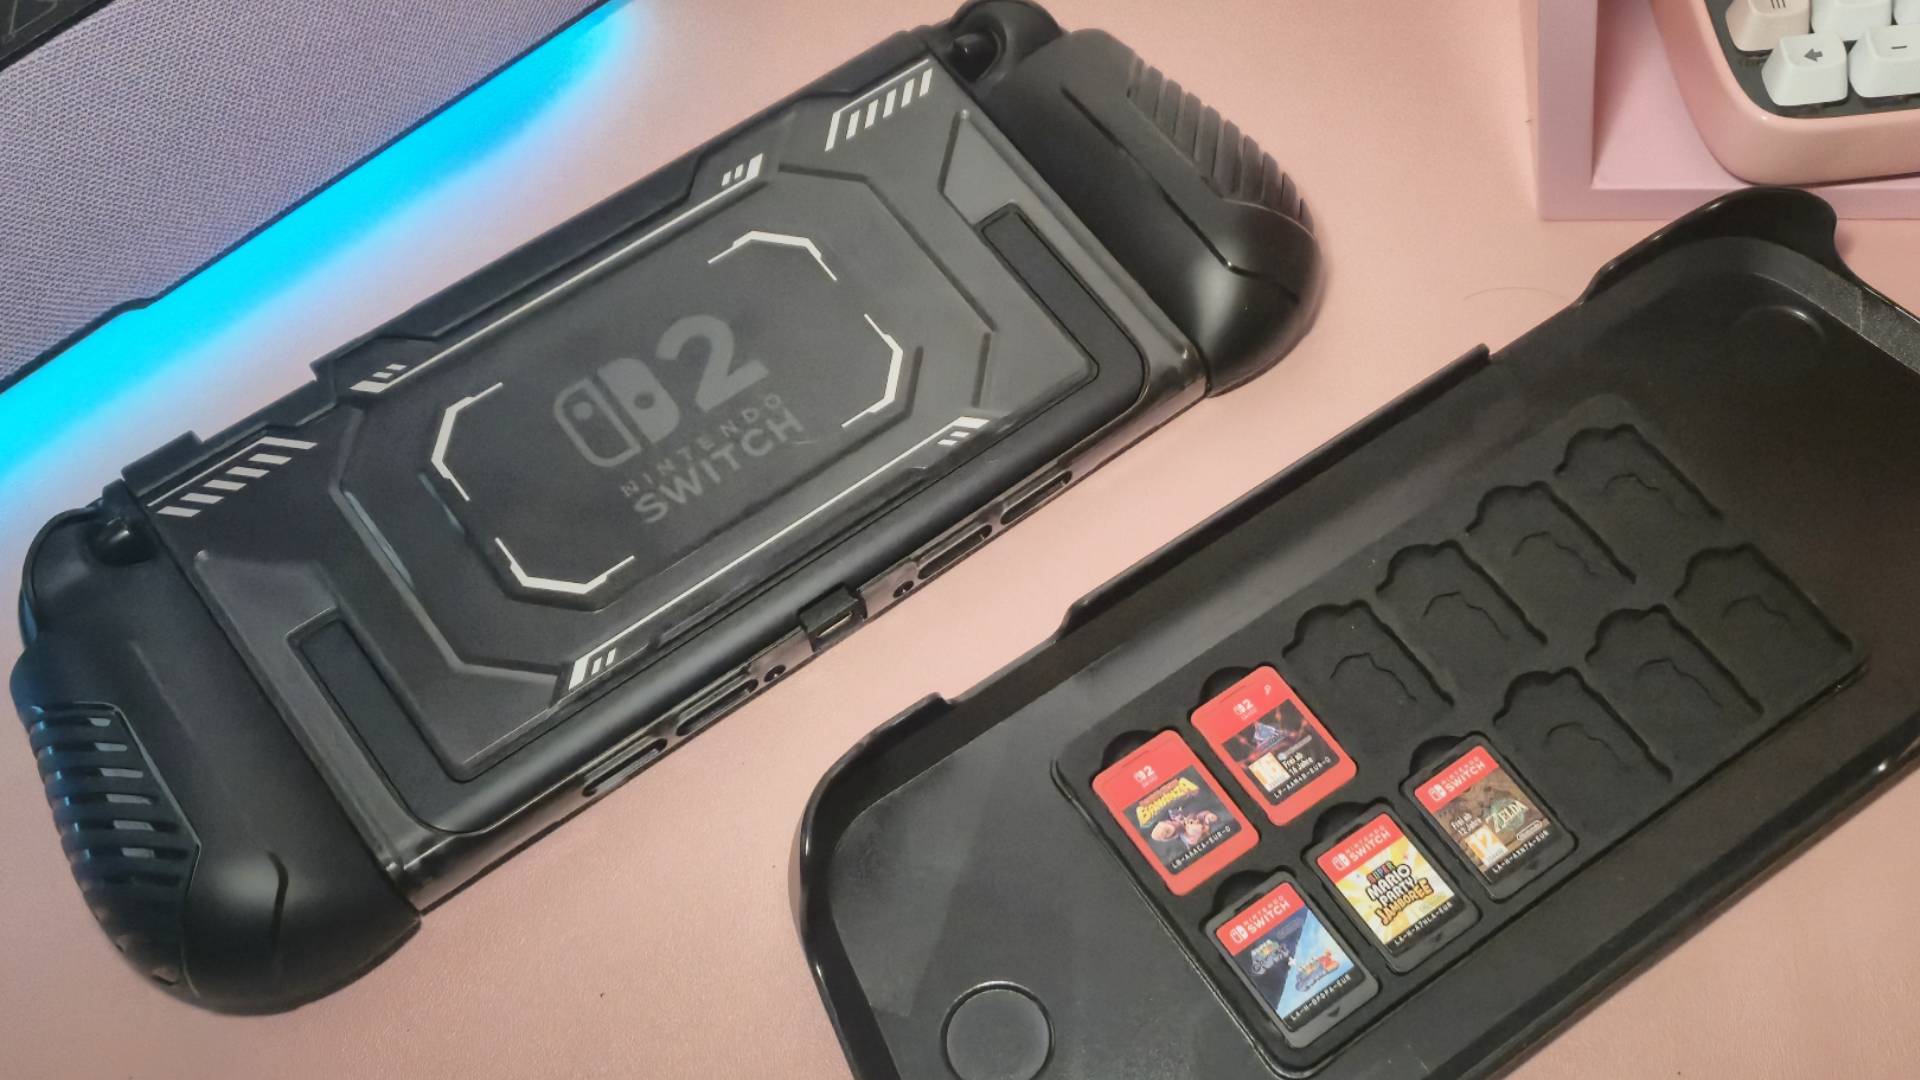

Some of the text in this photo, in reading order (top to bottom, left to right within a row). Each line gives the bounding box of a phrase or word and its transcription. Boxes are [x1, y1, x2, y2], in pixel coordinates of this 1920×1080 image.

[655, 314, 769, 414] 2
[620, 393, 782, 498] NINTENDO
[634, 408, 805, 524] SWITCH
[1445, 761, 1486, 793] SWITCH
[1485, 799, 1529, 833] ZELDA
[1349, 829, 1391, 862] SWITCH
[1366, 863, 1412, 902] MARIO
[1378, 876, 1417, 907] PARTY
[1247, 900, 1291, 934] SWITCH
[1375, 877, 1434, 925] JAMBOREE
